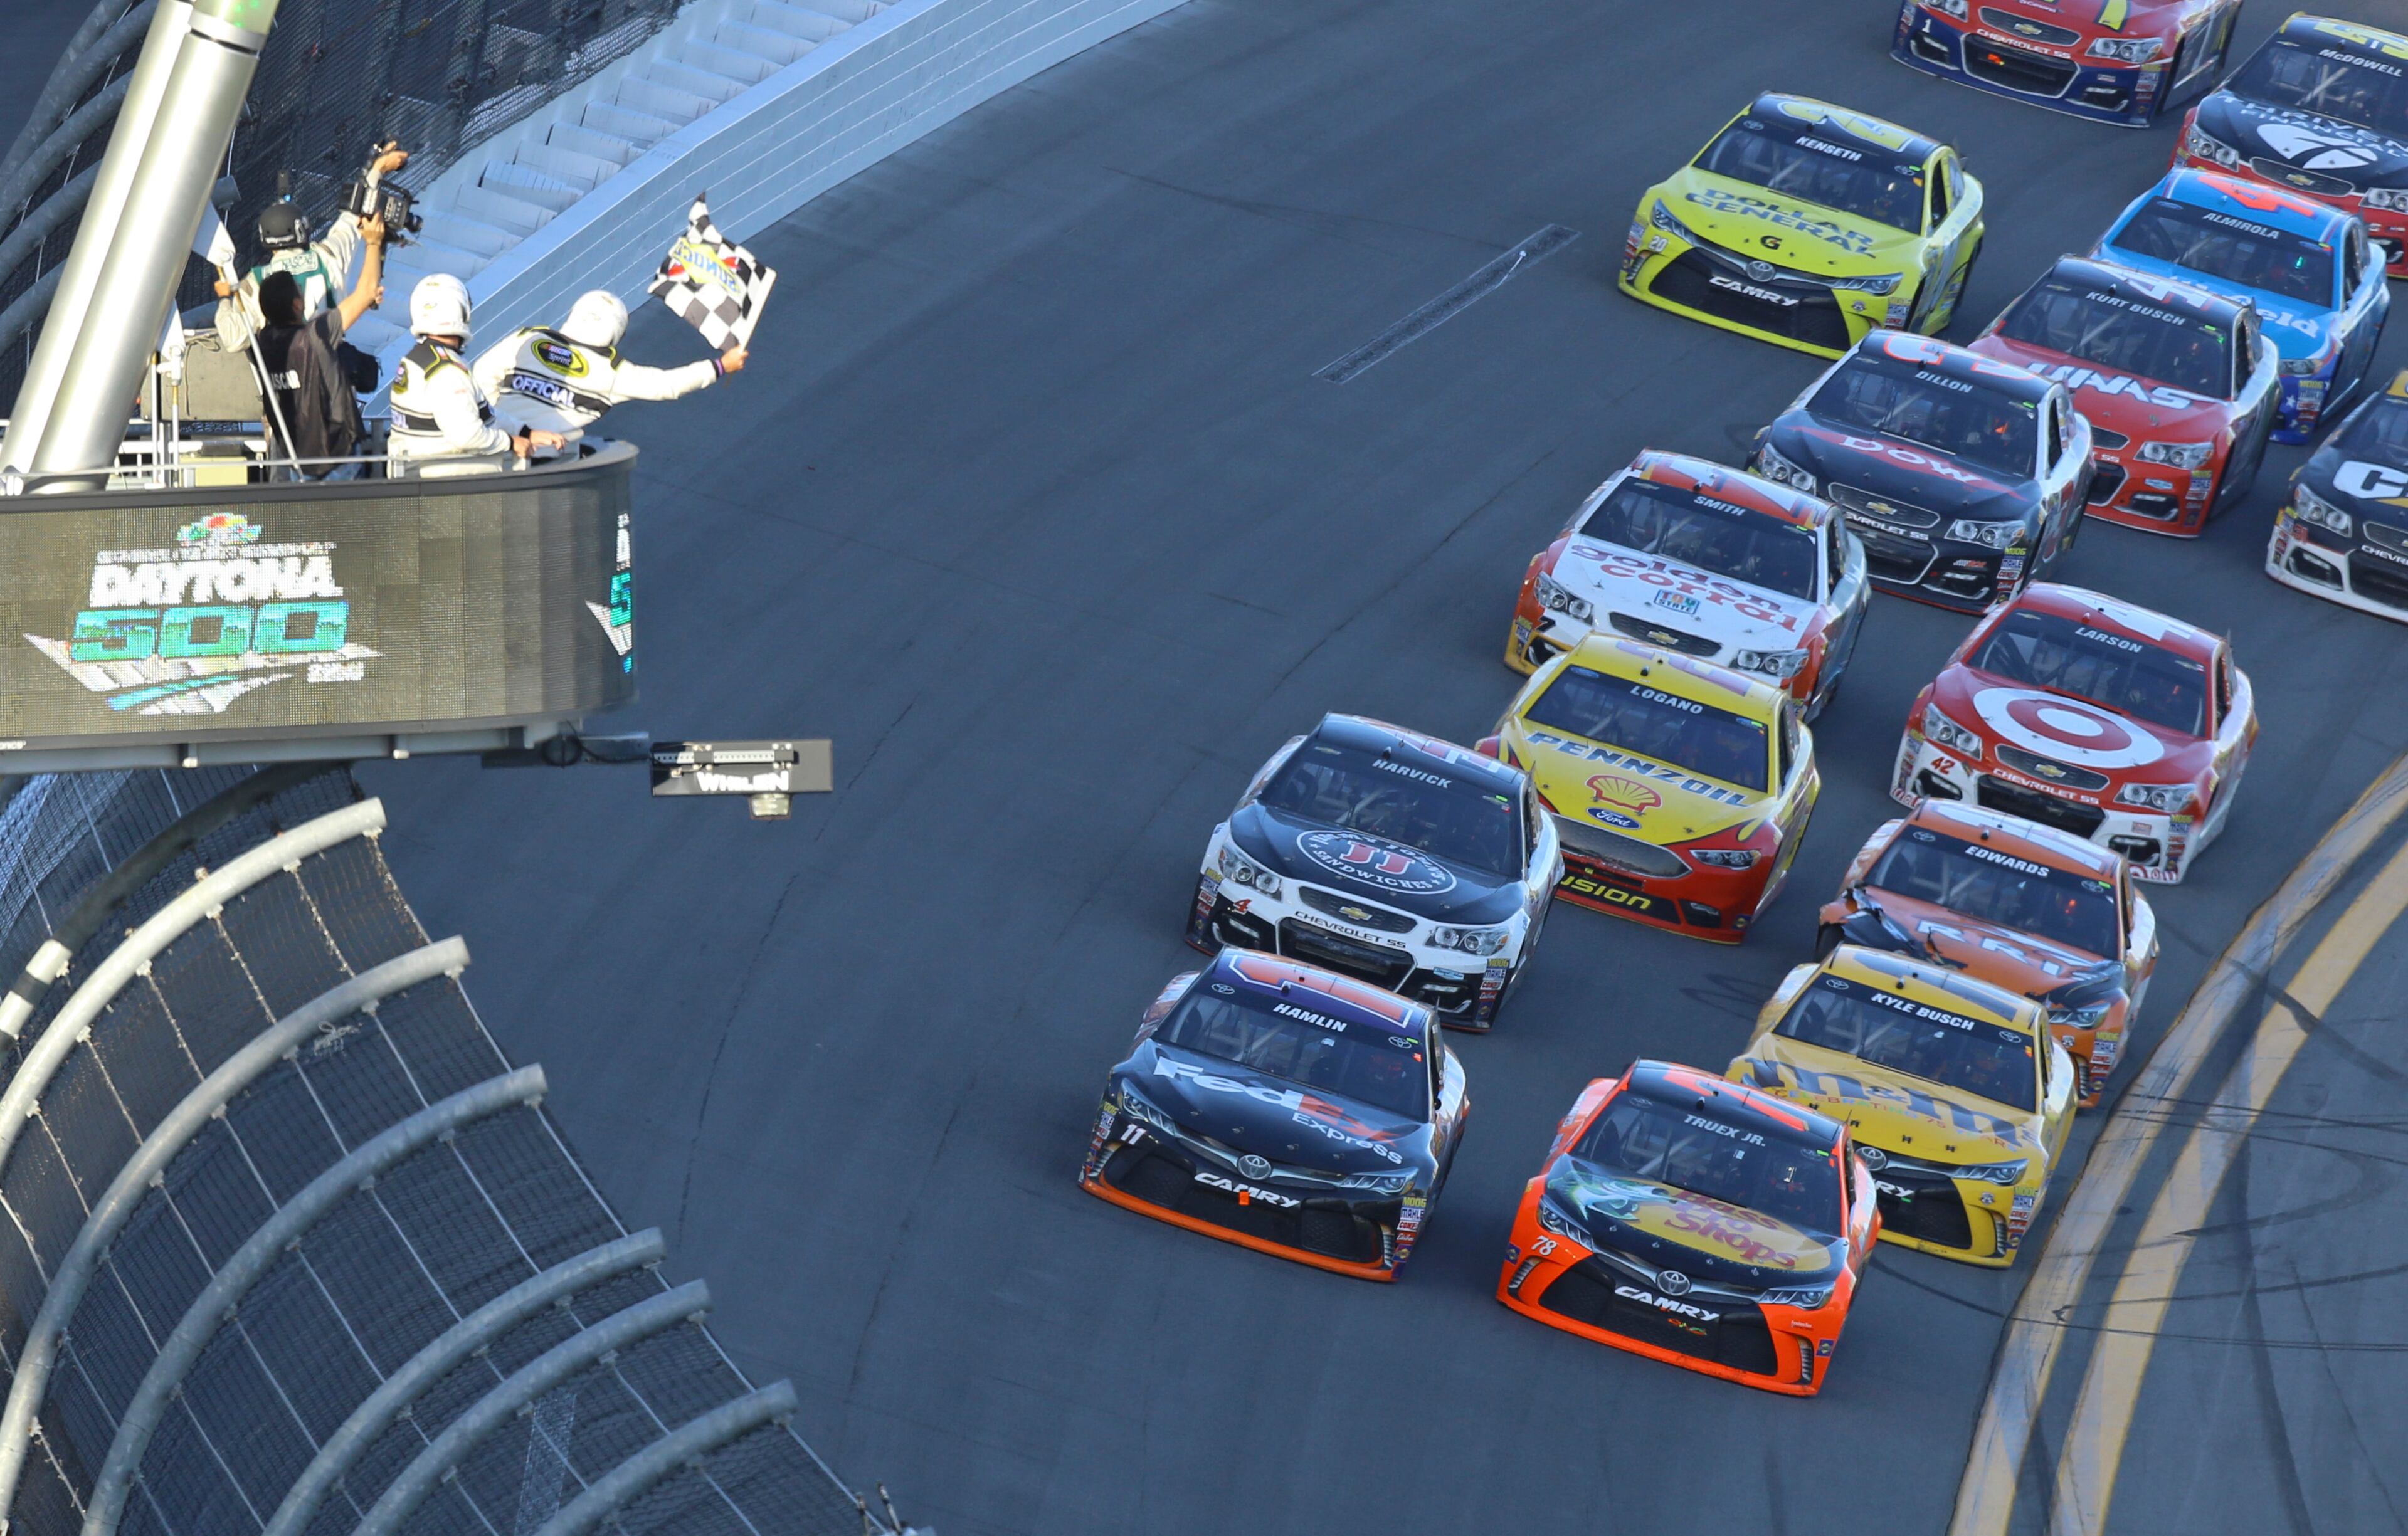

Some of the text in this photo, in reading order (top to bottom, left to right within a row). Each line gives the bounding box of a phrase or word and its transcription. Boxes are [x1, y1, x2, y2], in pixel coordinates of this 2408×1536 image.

[1977, 28, 2071, 58] CHEVROLET SS
[2319, 48, 2403, 78] McDOWELL
[2218, 95, 2408, 156] THRIVEN
[2241, 109, 2407, 158] FINANCIAL
[1795, 135, 1862, 162] KENSETH
[1685, 192, 1877, 259] GENERAL
[1705, 189, 1874, 246] DOLLAR
[2202, 212, 2280, 240] ALMIROLA
[1649, 235, 1668, 252] 20
[1709, 276, 1800, 307] CAMRY
[2085, 290, 2186, 327] KURT BUSCH
[512, 376, 575, 409] OFFICIAL
[1914, 369, 1973, 394] DILLON
[1839, 435, 1982, 483] DOW
[1693, 495, 1746, 517] SMITH
[1909, 530, 1930, 541] SS
[2361, 544, 2408, 567] CHEVR
[89, 554, 345, 608] DAYTONA
[71, 601, 350, 662] 500
[2075, 626, 2143, 653] LARSON
[1630, 685, 1704, 715] LOGANO
[1372, 758, 1452, 789] HARVICK
[1525, 730, 1751, 809] PENNZOIL
[1931, 755, 1955, 775] 42
[1992, 767, 2099, 806] CHEVROLET SS
[1596, 810, 1631, 827] Ford
[1312, 849, 1434, 890] SANDWICHES
[1339, 840, 1416, 875] JJ
[1965, 845, 2050, 878] EDWARDS
[1233, 898, 1252, 915] 4
[1295, 910, 1407, 949] CHEVROLET SS
[1273, 1002, 1348, 1032] HAMLIN
[1871, 992, 1975, 1031] KYLE BUSCH
[1153, 1055, 1402, 1147] FedEx
[1120, 1124, 1146, 1145] 11
[1292, 1112, 1404, 1165] Express
[1683, 1113, 1766, 1147] TRUEX JR.
[1193, 1171, 1302, 1209] CAMRY
[1403, 1196, 1427, 1207] MOOG
[1531, 1235, 1558, 1256] 78
[1664, 1212, 1799, 1270] Shops
[1613, 1286, 1721, 1322] CAMRY
